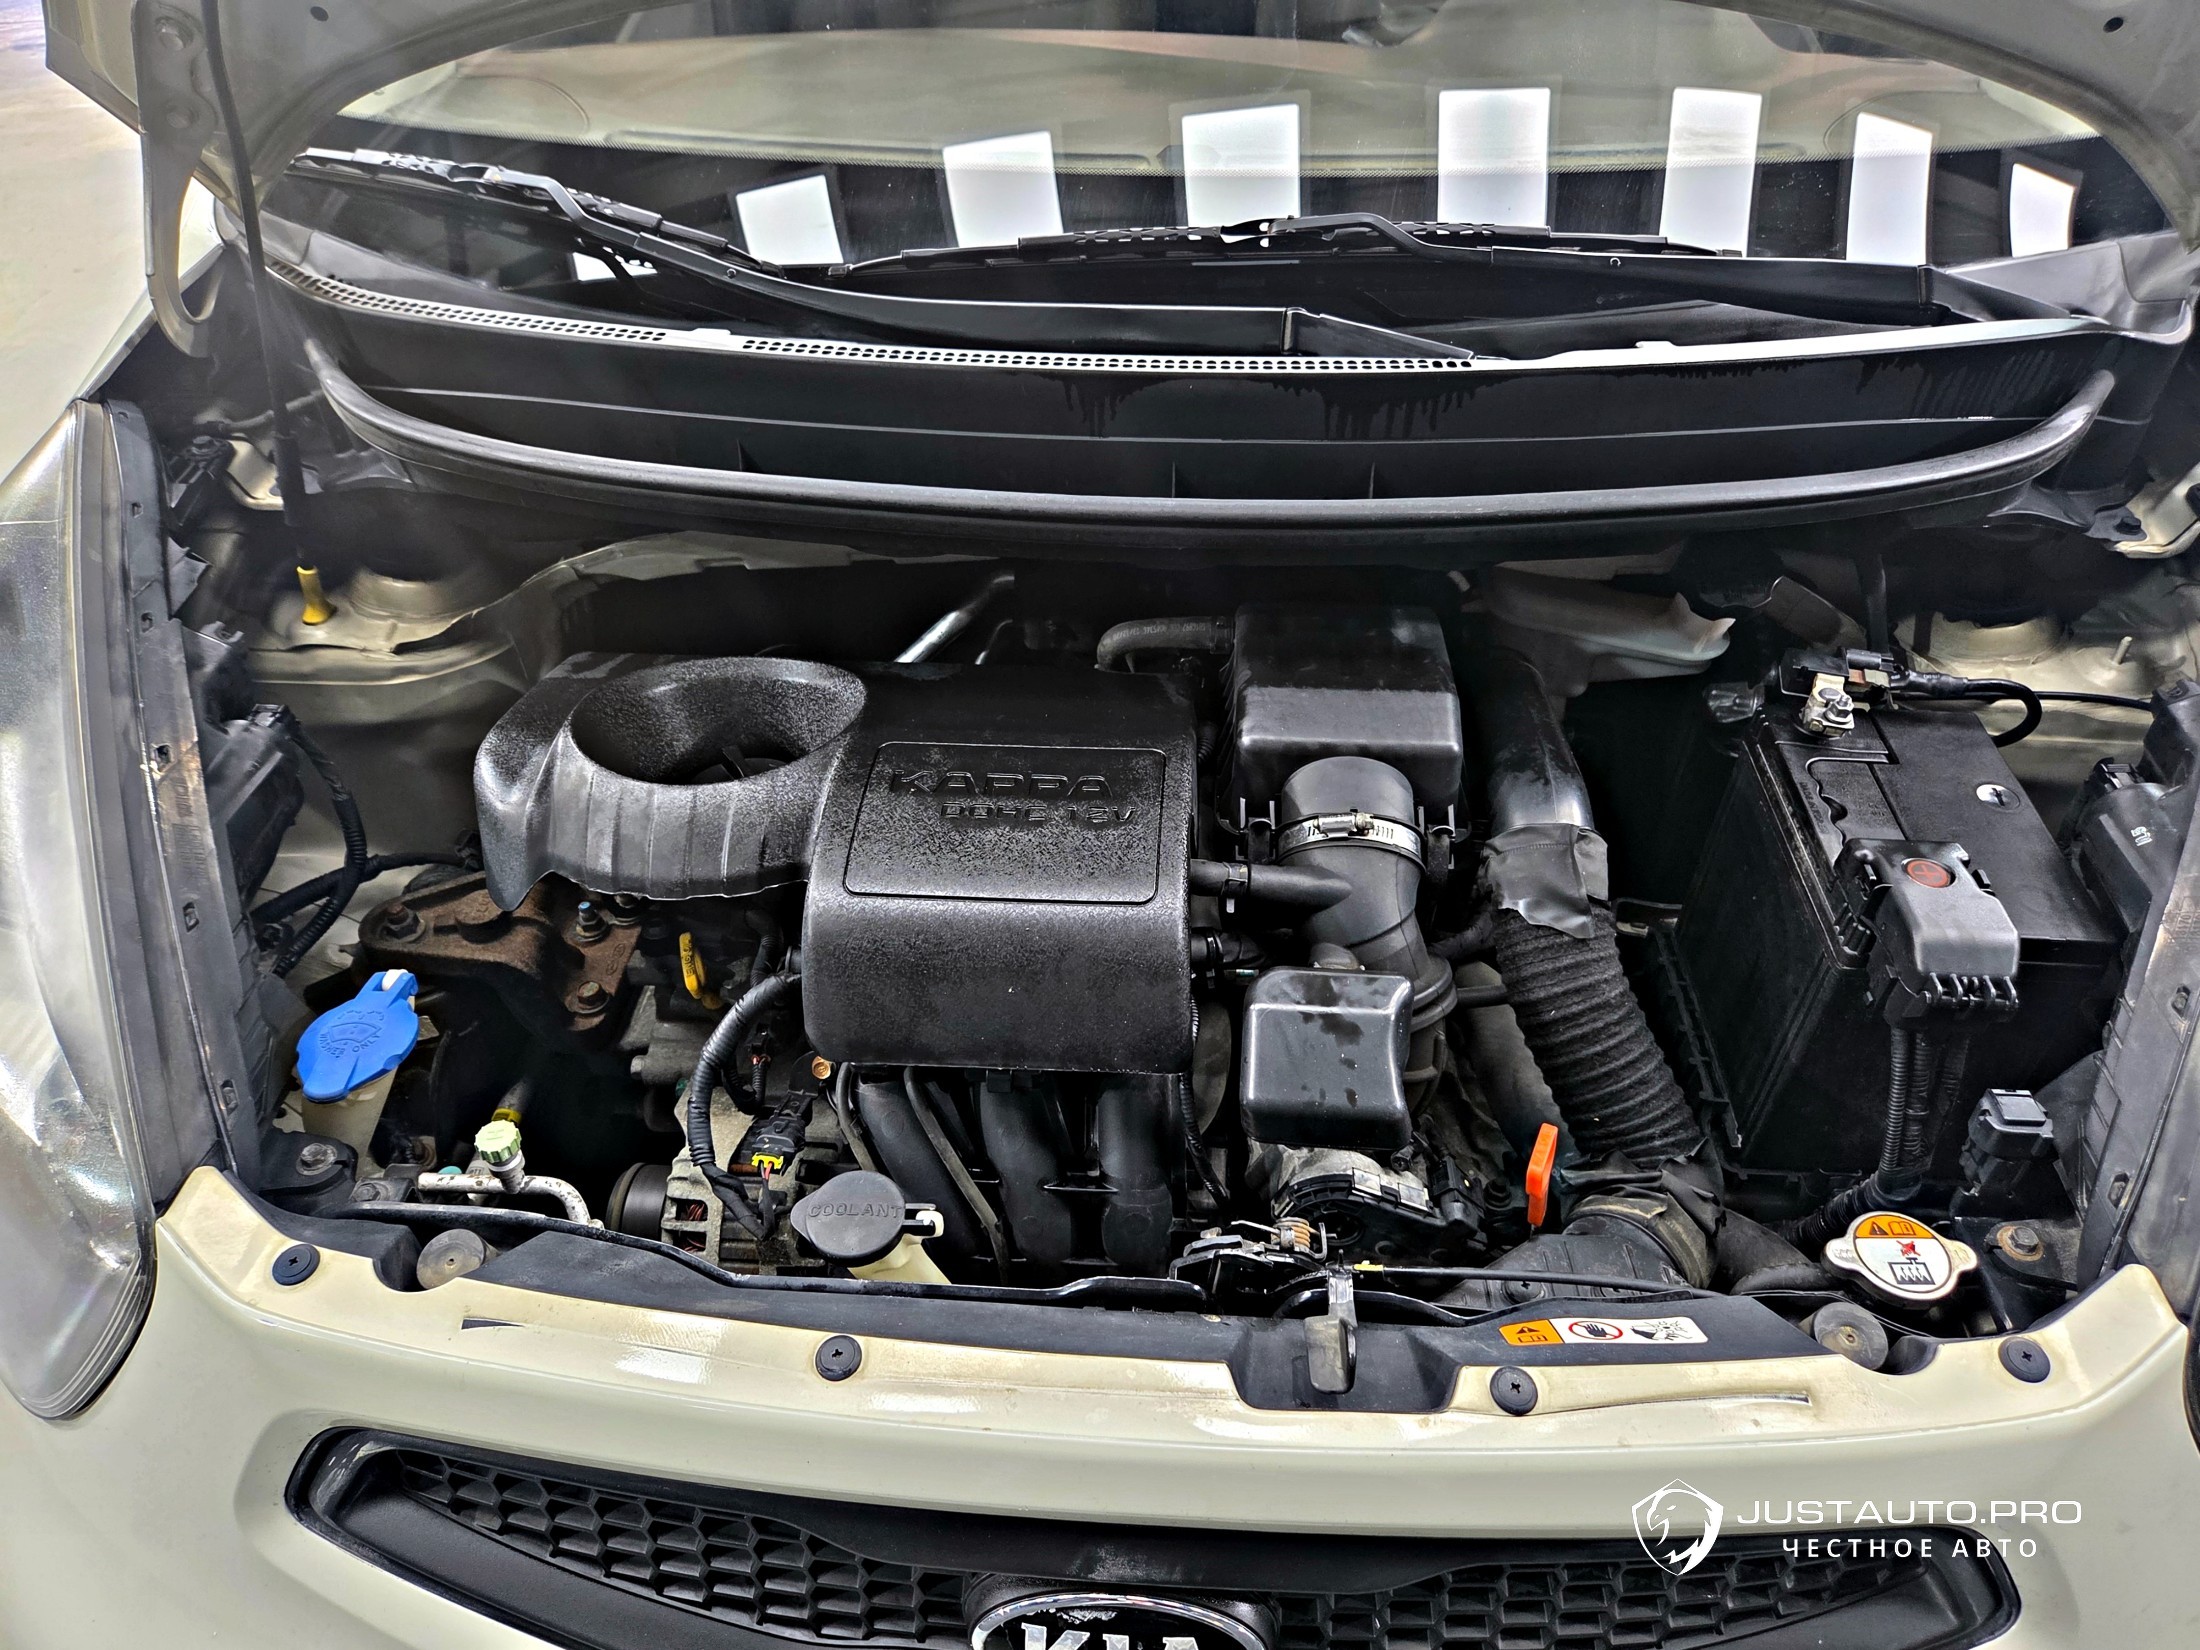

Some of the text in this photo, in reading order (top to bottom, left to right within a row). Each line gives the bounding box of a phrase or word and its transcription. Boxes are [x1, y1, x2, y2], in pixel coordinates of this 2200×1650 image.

[889, 769, 1113, 797] KAPPA
[940, 801, 1136, 823] DOHC 12V
[319, 1032, 346, 1058] WASHER
[351, 1035, 381, 1053] ONLY
[808, 1203, 902, 1219] COOLANT
